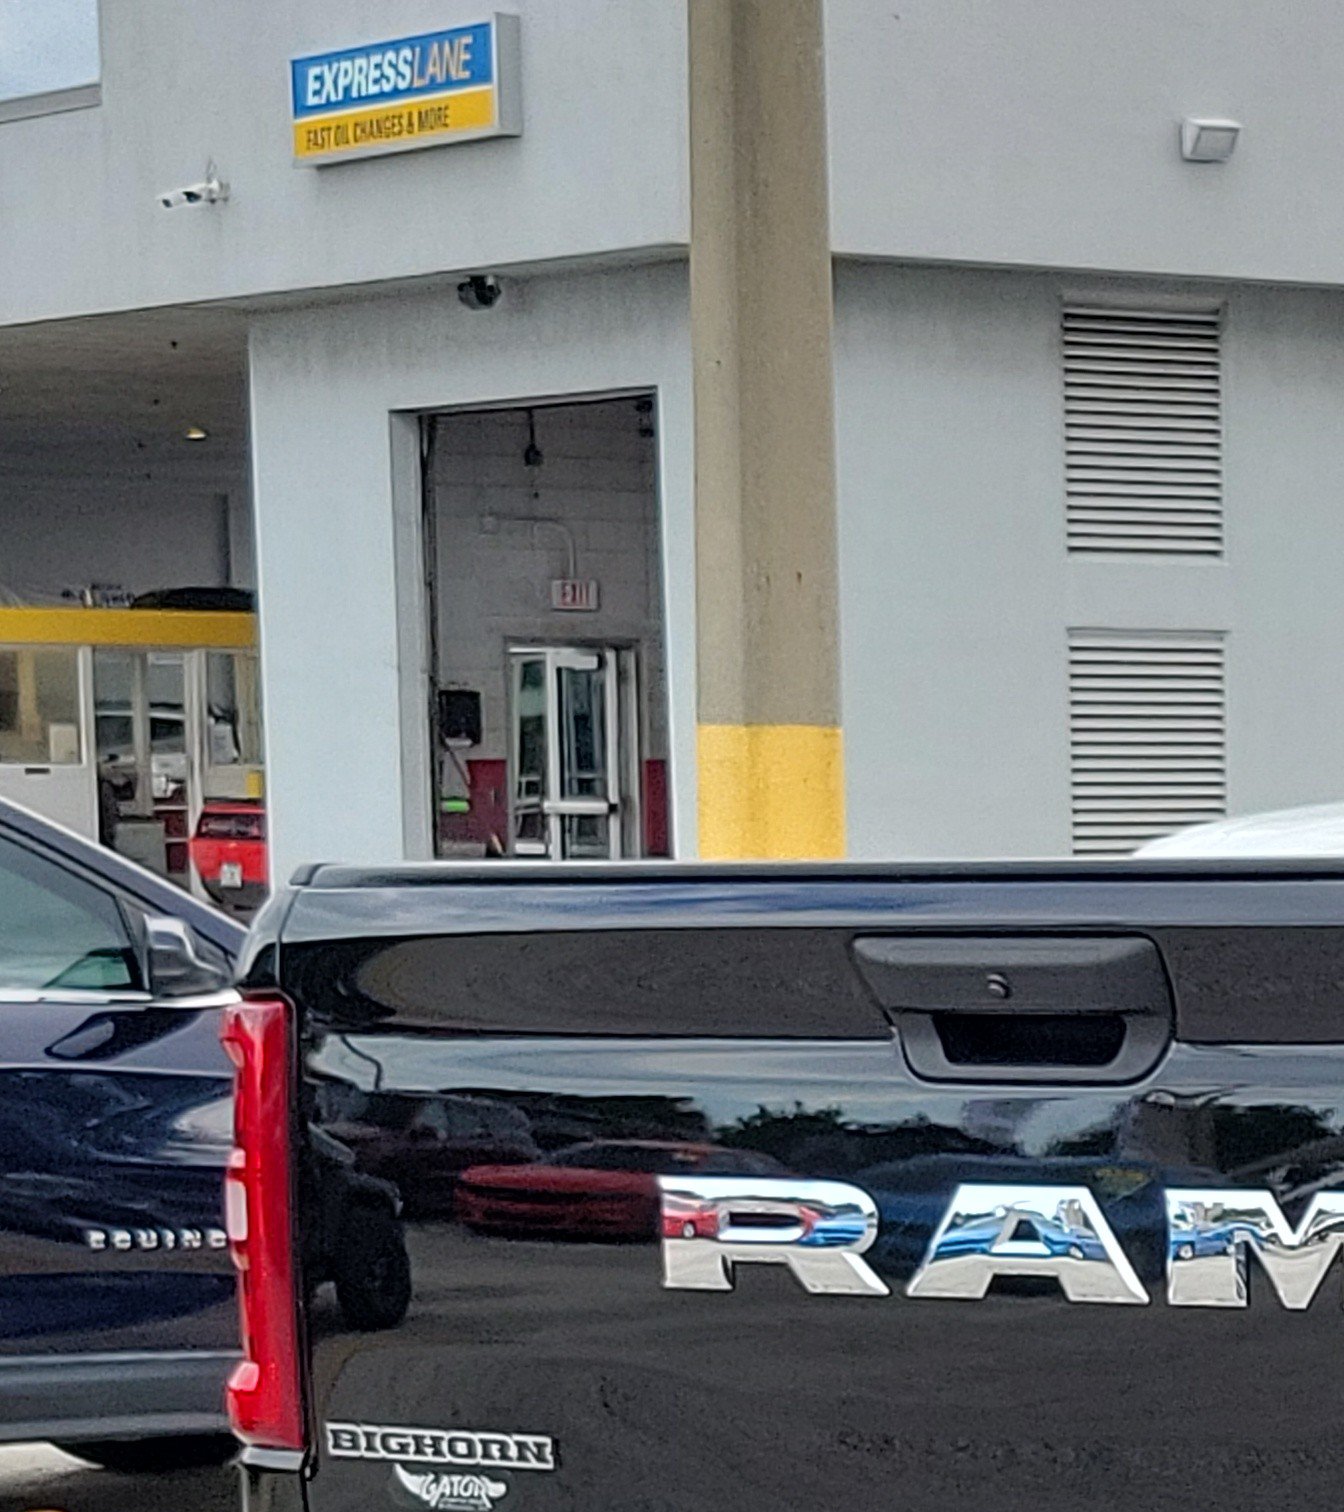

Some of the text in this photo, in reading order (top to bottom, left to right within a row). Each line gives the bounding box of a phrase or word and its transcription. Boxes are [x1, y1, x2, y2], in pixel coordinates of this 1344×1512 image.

[306, 34, 473, 106] EXPRESSLANE
[305, 105, 450, 151] FAST OIL CHANGES & MORE
[560, 582, 589, 605] EXIT
[87, 1228, 227, 1250] EQUINO
[325, 1421, 555, 1470] BIGHORN
